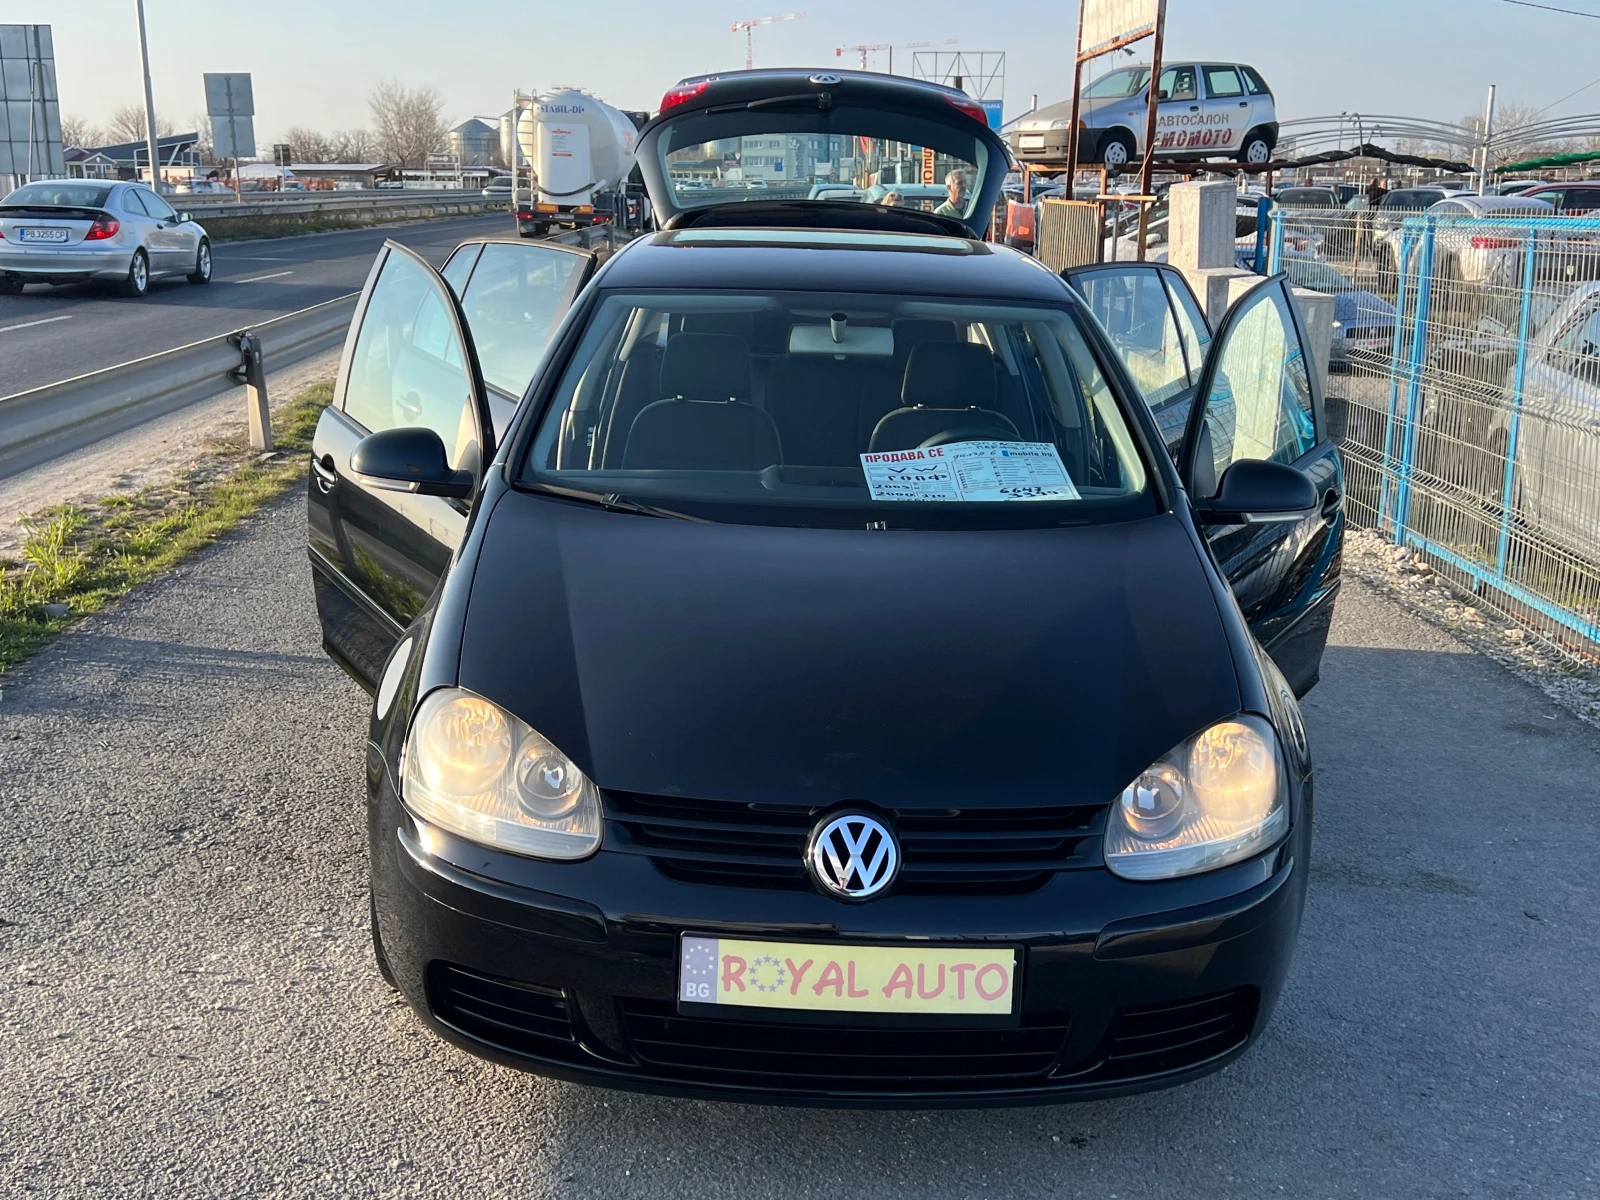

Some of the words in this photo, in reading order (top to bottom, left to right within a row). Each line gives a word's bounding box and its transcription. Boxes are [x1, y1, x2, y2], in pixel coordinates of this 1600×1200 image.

[1158, 113, 1229, 127] АВТОСАЛОН
[865, 450, 925, 463] ПРОДАВА
[928, 447, 945, 458] СЕ
[685, 982, 710, 999] BG
[882, 962, 1009, 1001] AUTO
